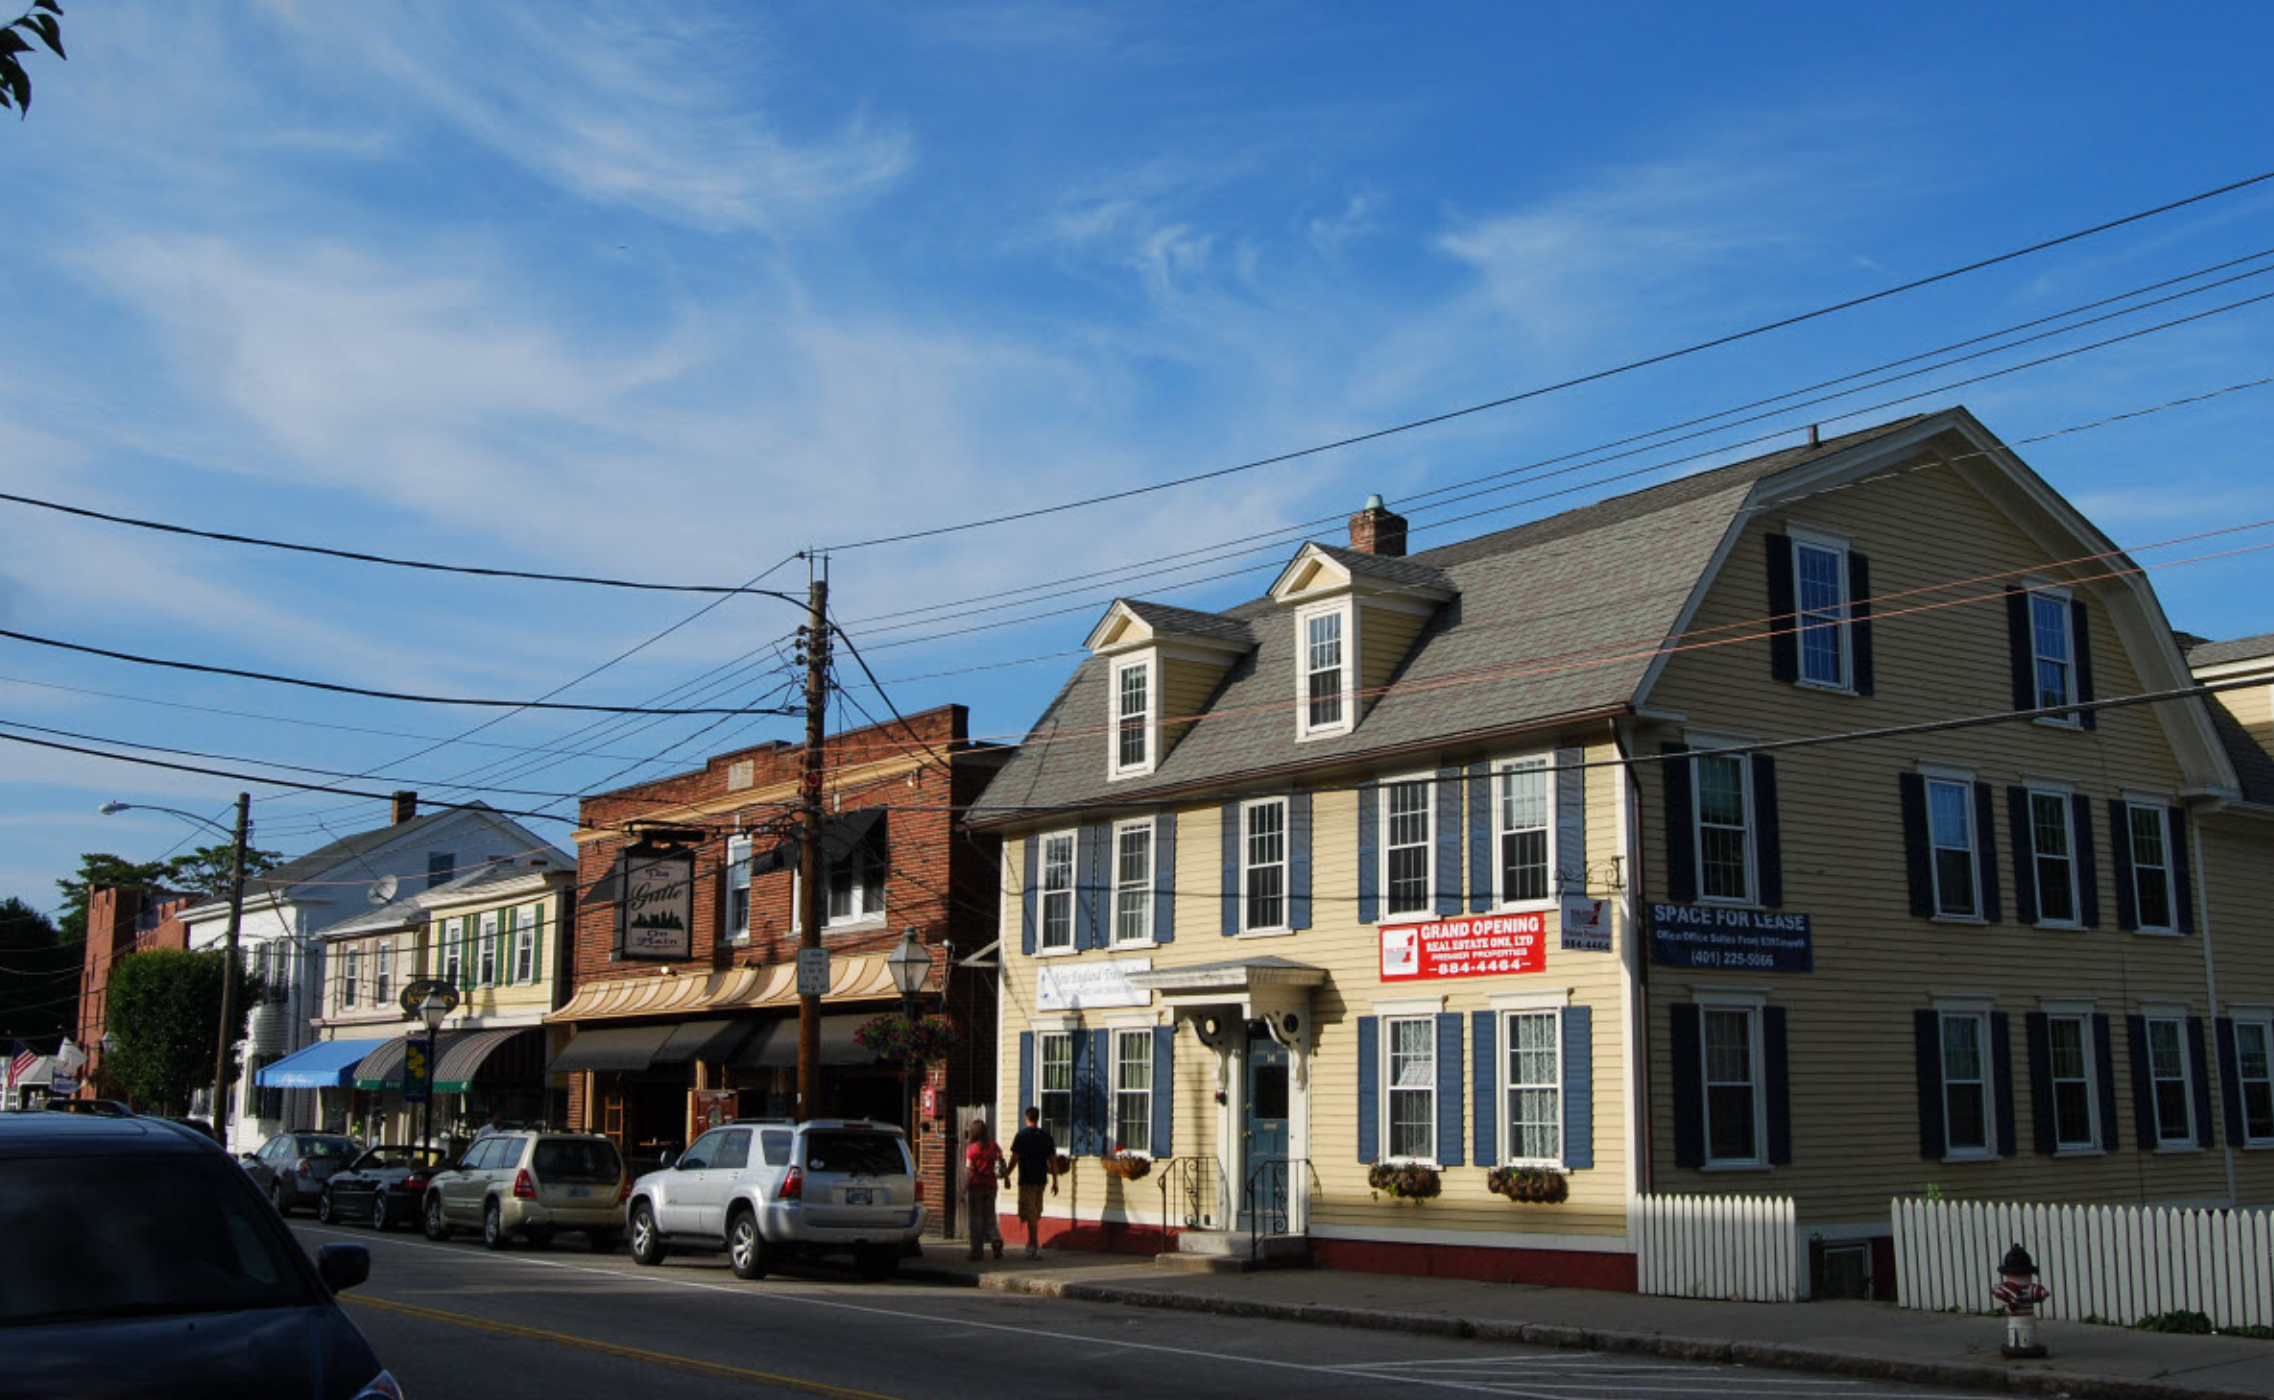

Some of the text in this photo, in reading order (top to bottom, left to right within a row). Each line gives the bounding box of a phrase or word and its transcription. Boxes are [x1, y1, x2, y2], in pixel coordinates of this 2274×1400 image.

[645, 868, 669, 878] The
[1655, 904, 1806, 932] SPACE FOR LEASE
[1421, 916, 1539, 940] GRAND OPENING
[1426, 940, 1451, 953] REAL
[1452, 937, 1489, 950] ESTATE
[1514, 934, 1534, 946] LTD
[1431, 947, 1528, 961] PREMIER PROPERTIES
[1691, 951, 1722, 967] (401)
